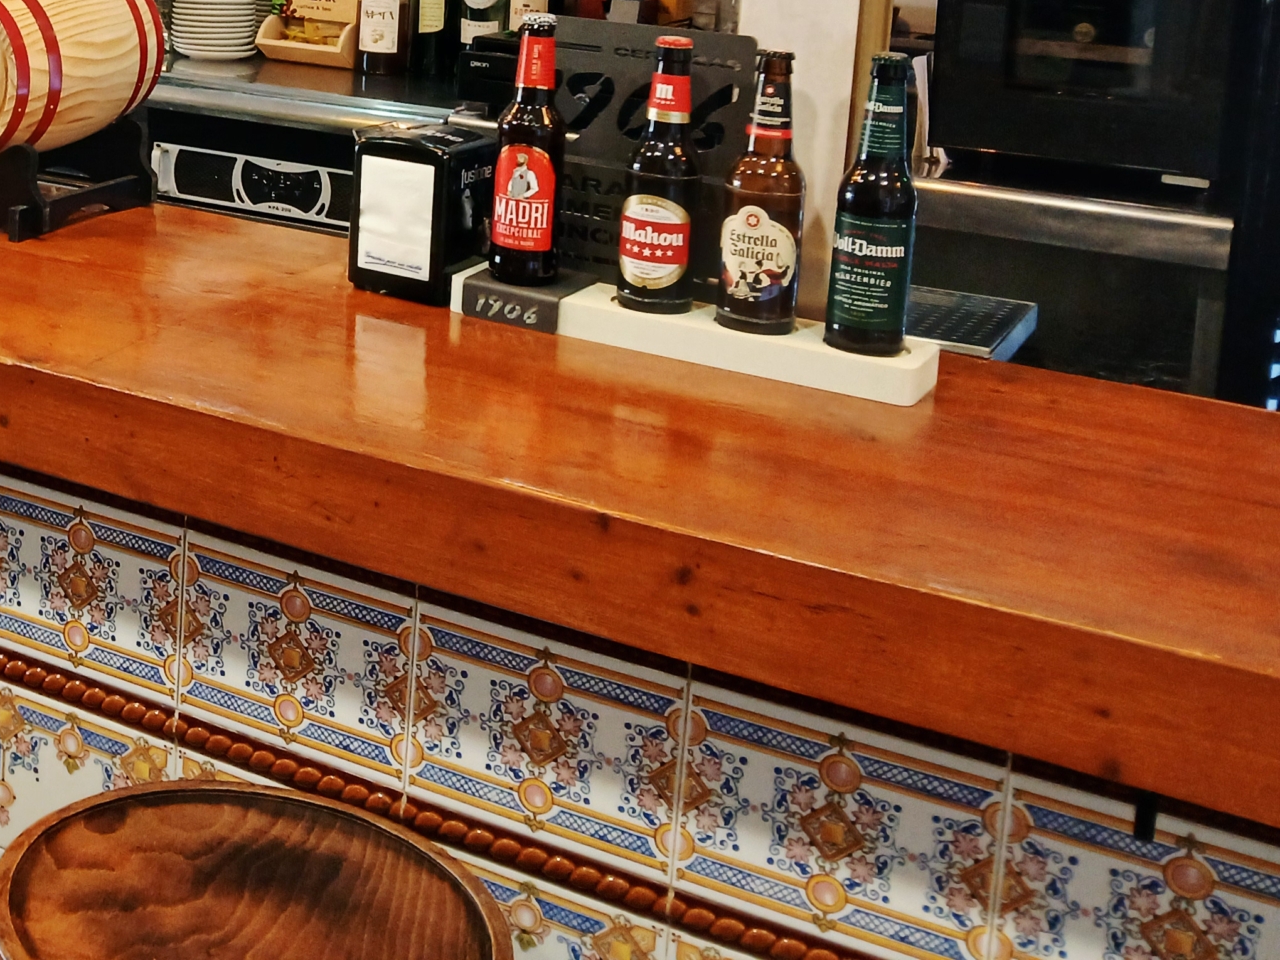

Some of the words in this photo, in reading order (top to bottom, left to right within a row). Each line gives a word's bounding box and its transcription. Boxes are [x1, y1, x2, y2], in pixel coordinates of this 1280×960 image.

[622, 220, 684, 246] Mahou
[729, 228, 778, 248] Estrella
[730, 242, 774, 262] Galicia
[475, 294, 539, 324] 1906
